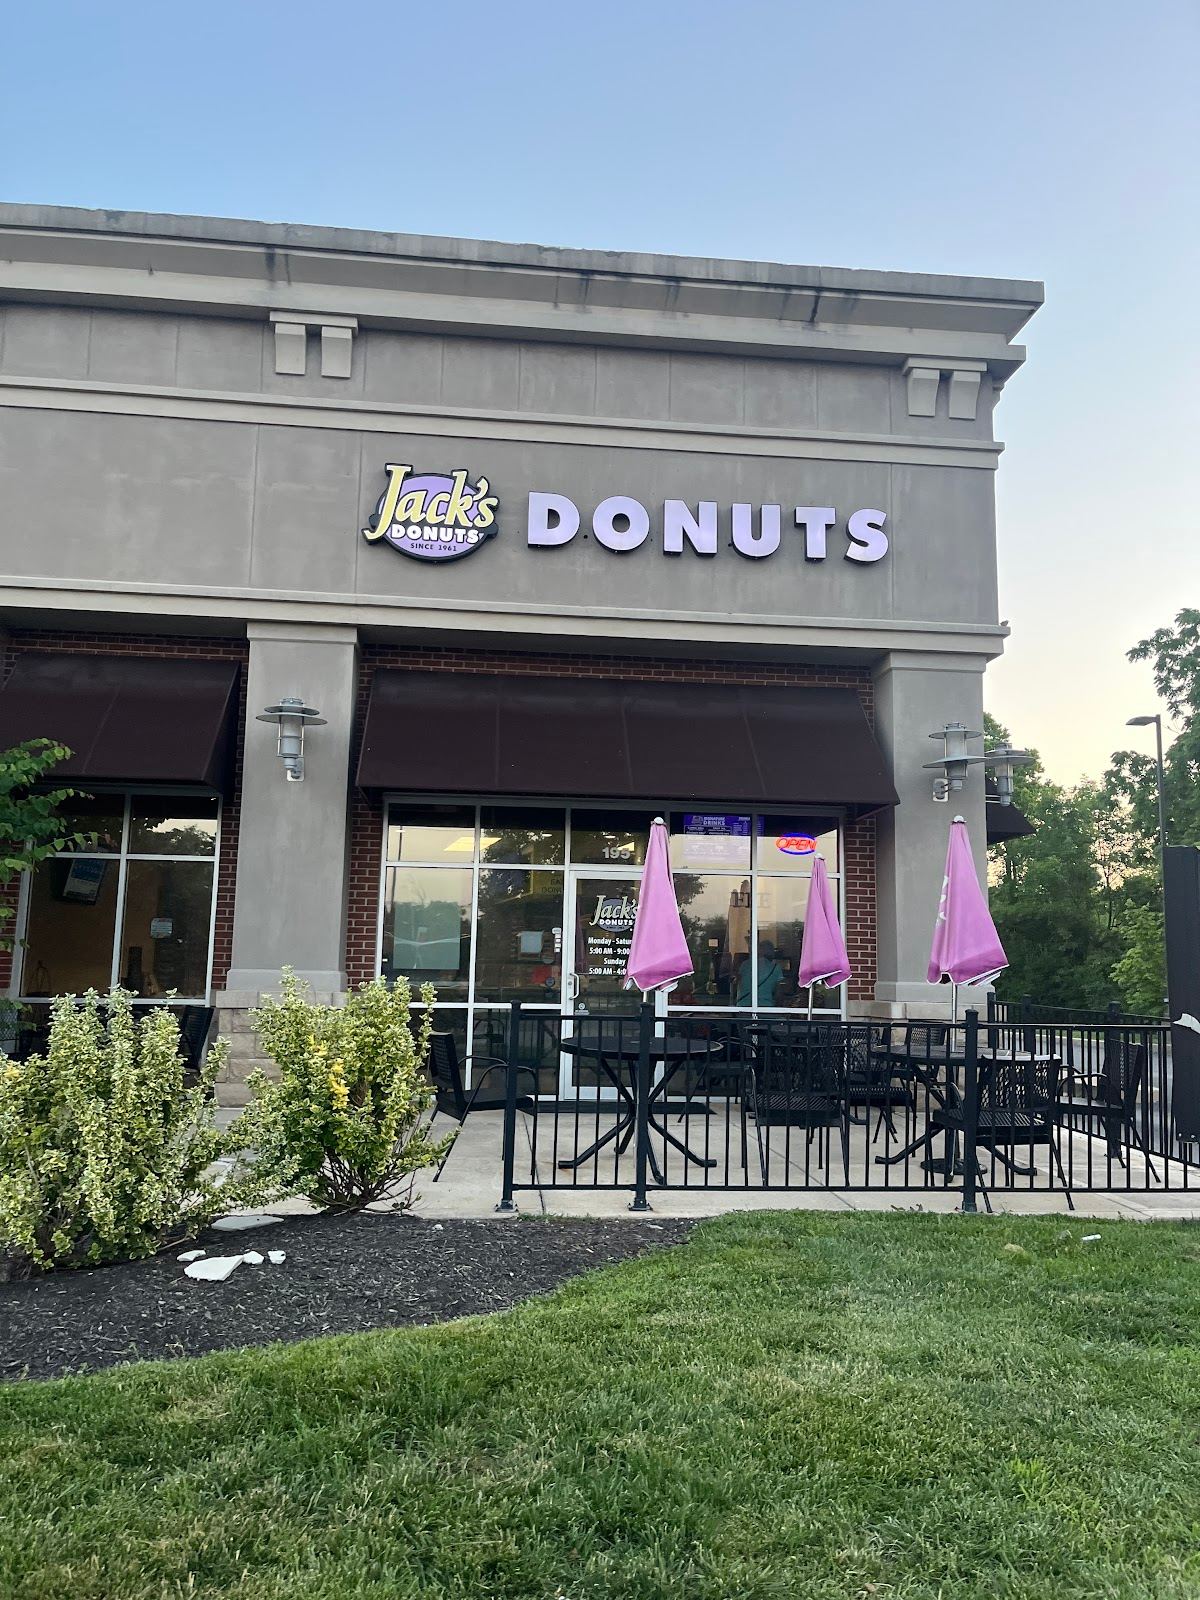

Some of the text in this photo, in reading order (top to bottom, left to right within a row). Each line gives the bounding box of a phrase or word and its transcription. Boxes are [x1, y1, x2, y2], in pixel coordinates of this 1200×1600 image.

[363, 465, 498, 540] Jack's
[392, 524, 480, 544] DONUTS
[527, 492, 889, 563] DONUTS
[776, 838, 817, 850] OPEN
[602, 847, 631, 859] 195
[589, 895, 637, 926] Jack's
[587, 937, 612, 945] Monday
[604, 957, 626, 966] Sunday
